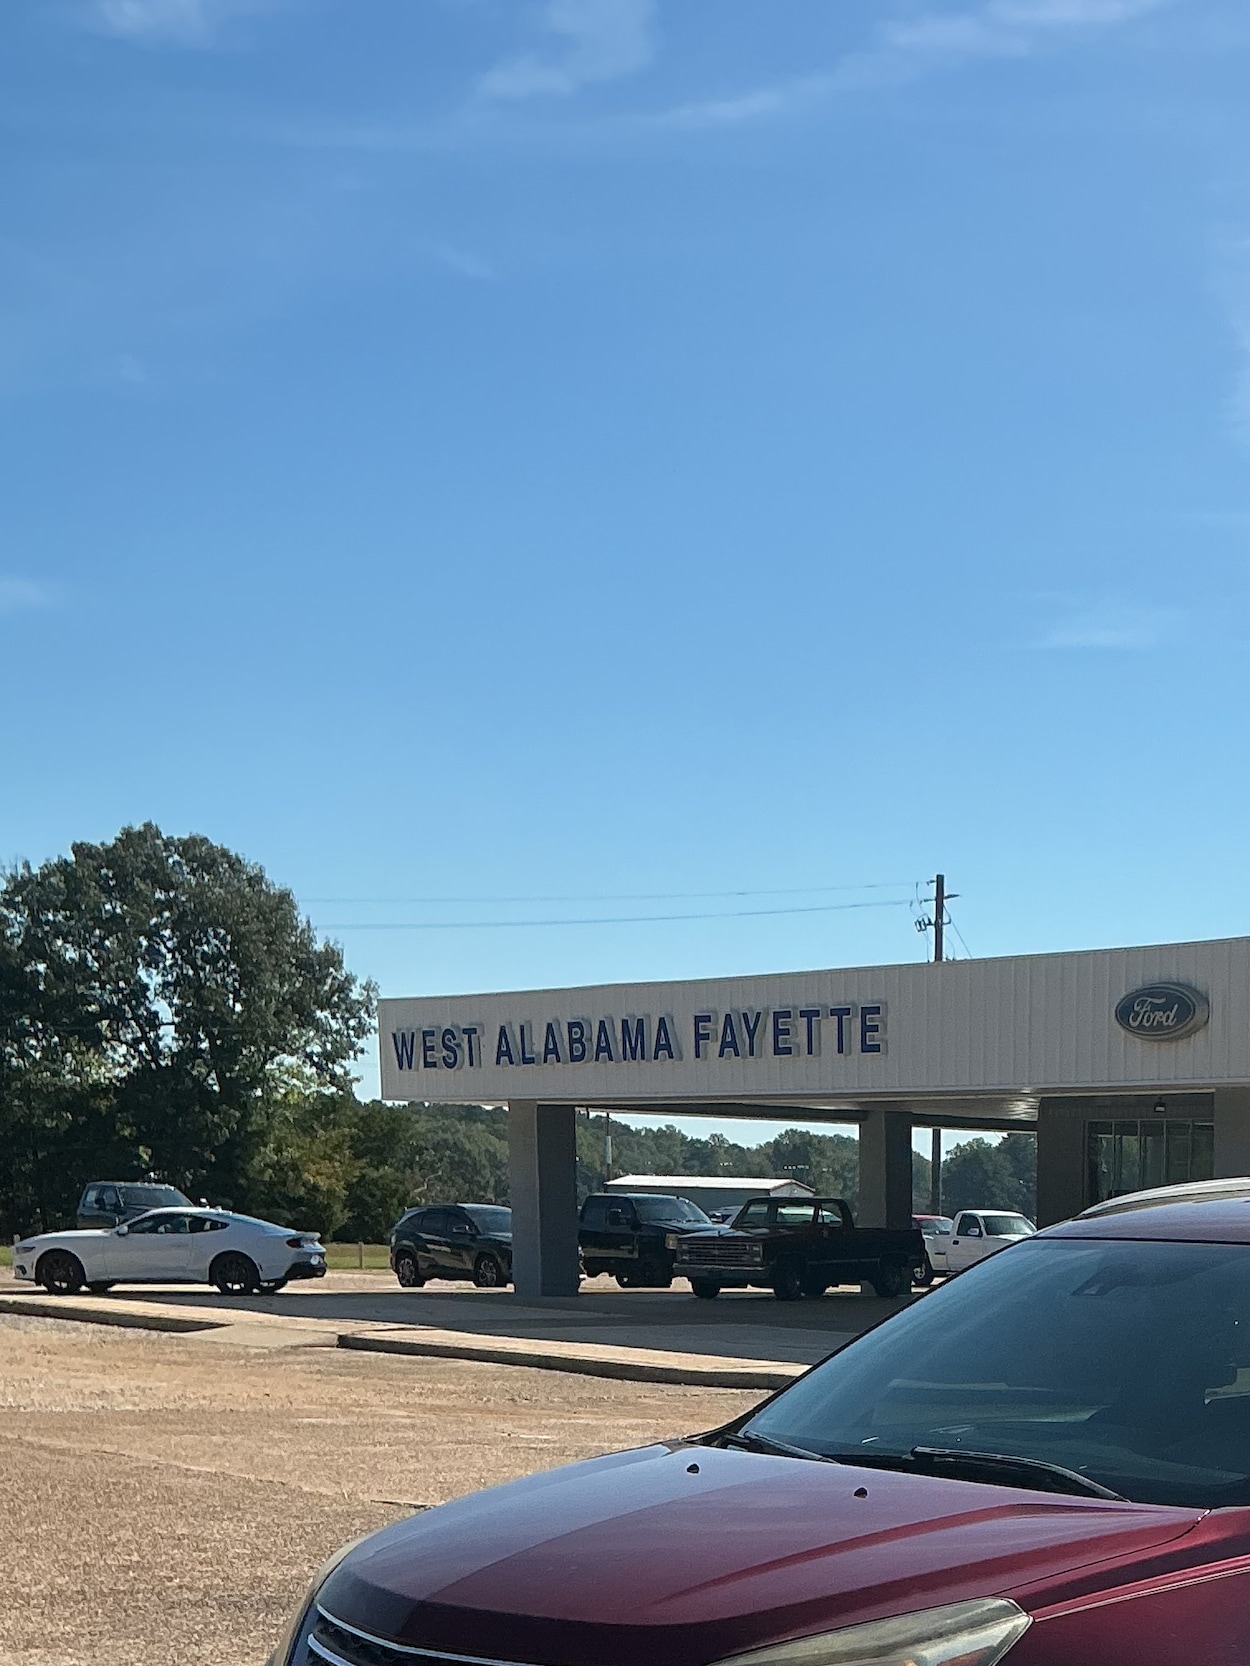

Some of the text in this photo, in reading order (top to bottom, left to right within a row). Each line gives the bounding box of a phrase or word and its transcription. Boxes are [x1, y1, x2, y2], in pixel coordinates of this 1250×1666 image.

[1128, 996, 1178, 1027] Ford
[392, 1006, 881, 1071] WEST ALABAMA FAYETTE
